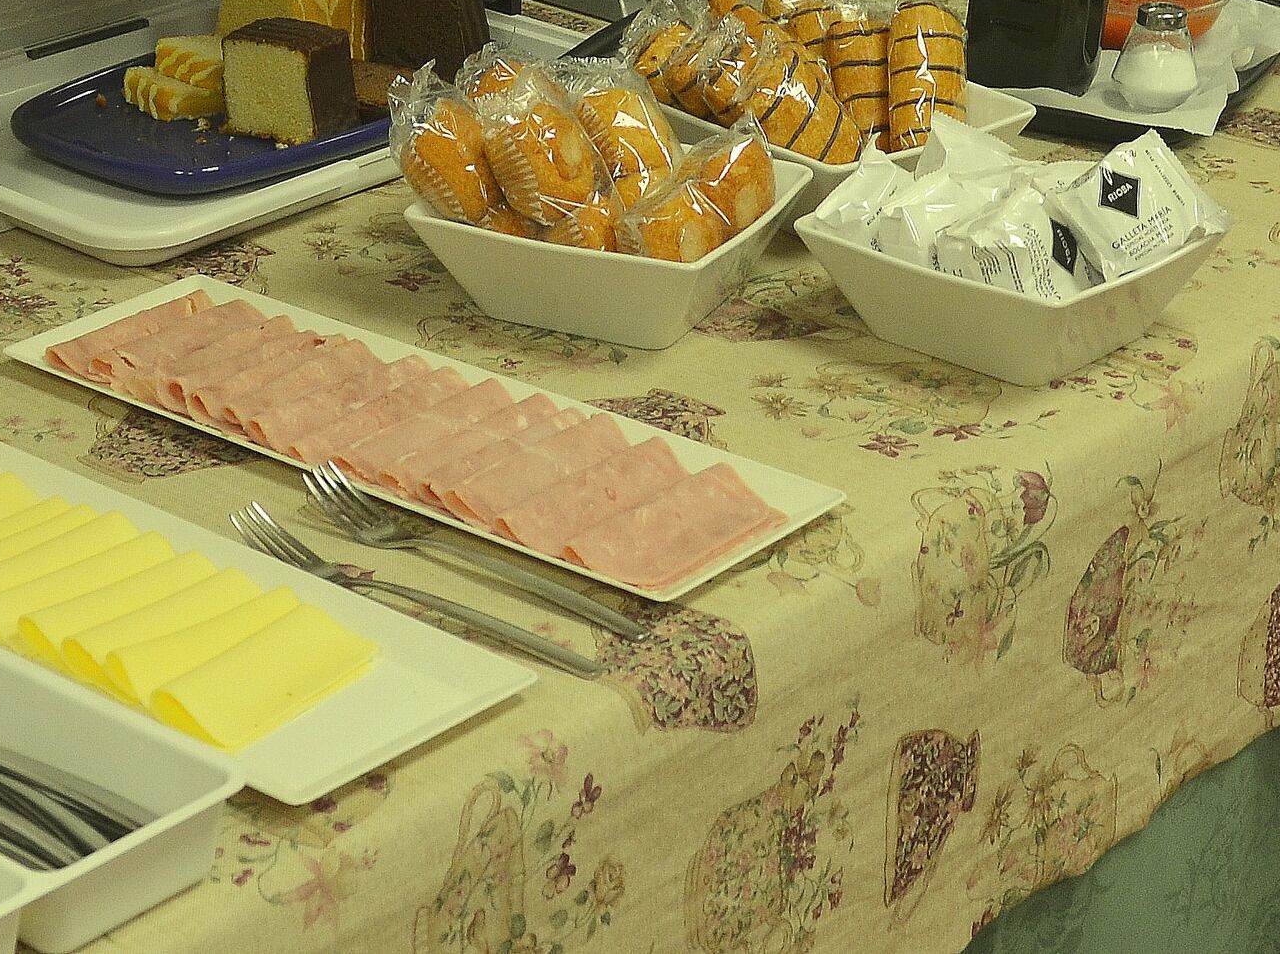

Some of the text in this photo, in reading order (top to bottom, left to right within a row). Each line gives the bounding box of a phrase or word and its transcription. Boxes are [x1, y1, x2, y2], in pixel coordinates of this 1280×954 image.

[1107, 182, 1134, 204] RIOBA
[1056, 228, 1073, 266] RIOBA
[1111, 223, 1147, 249] GALLETA
